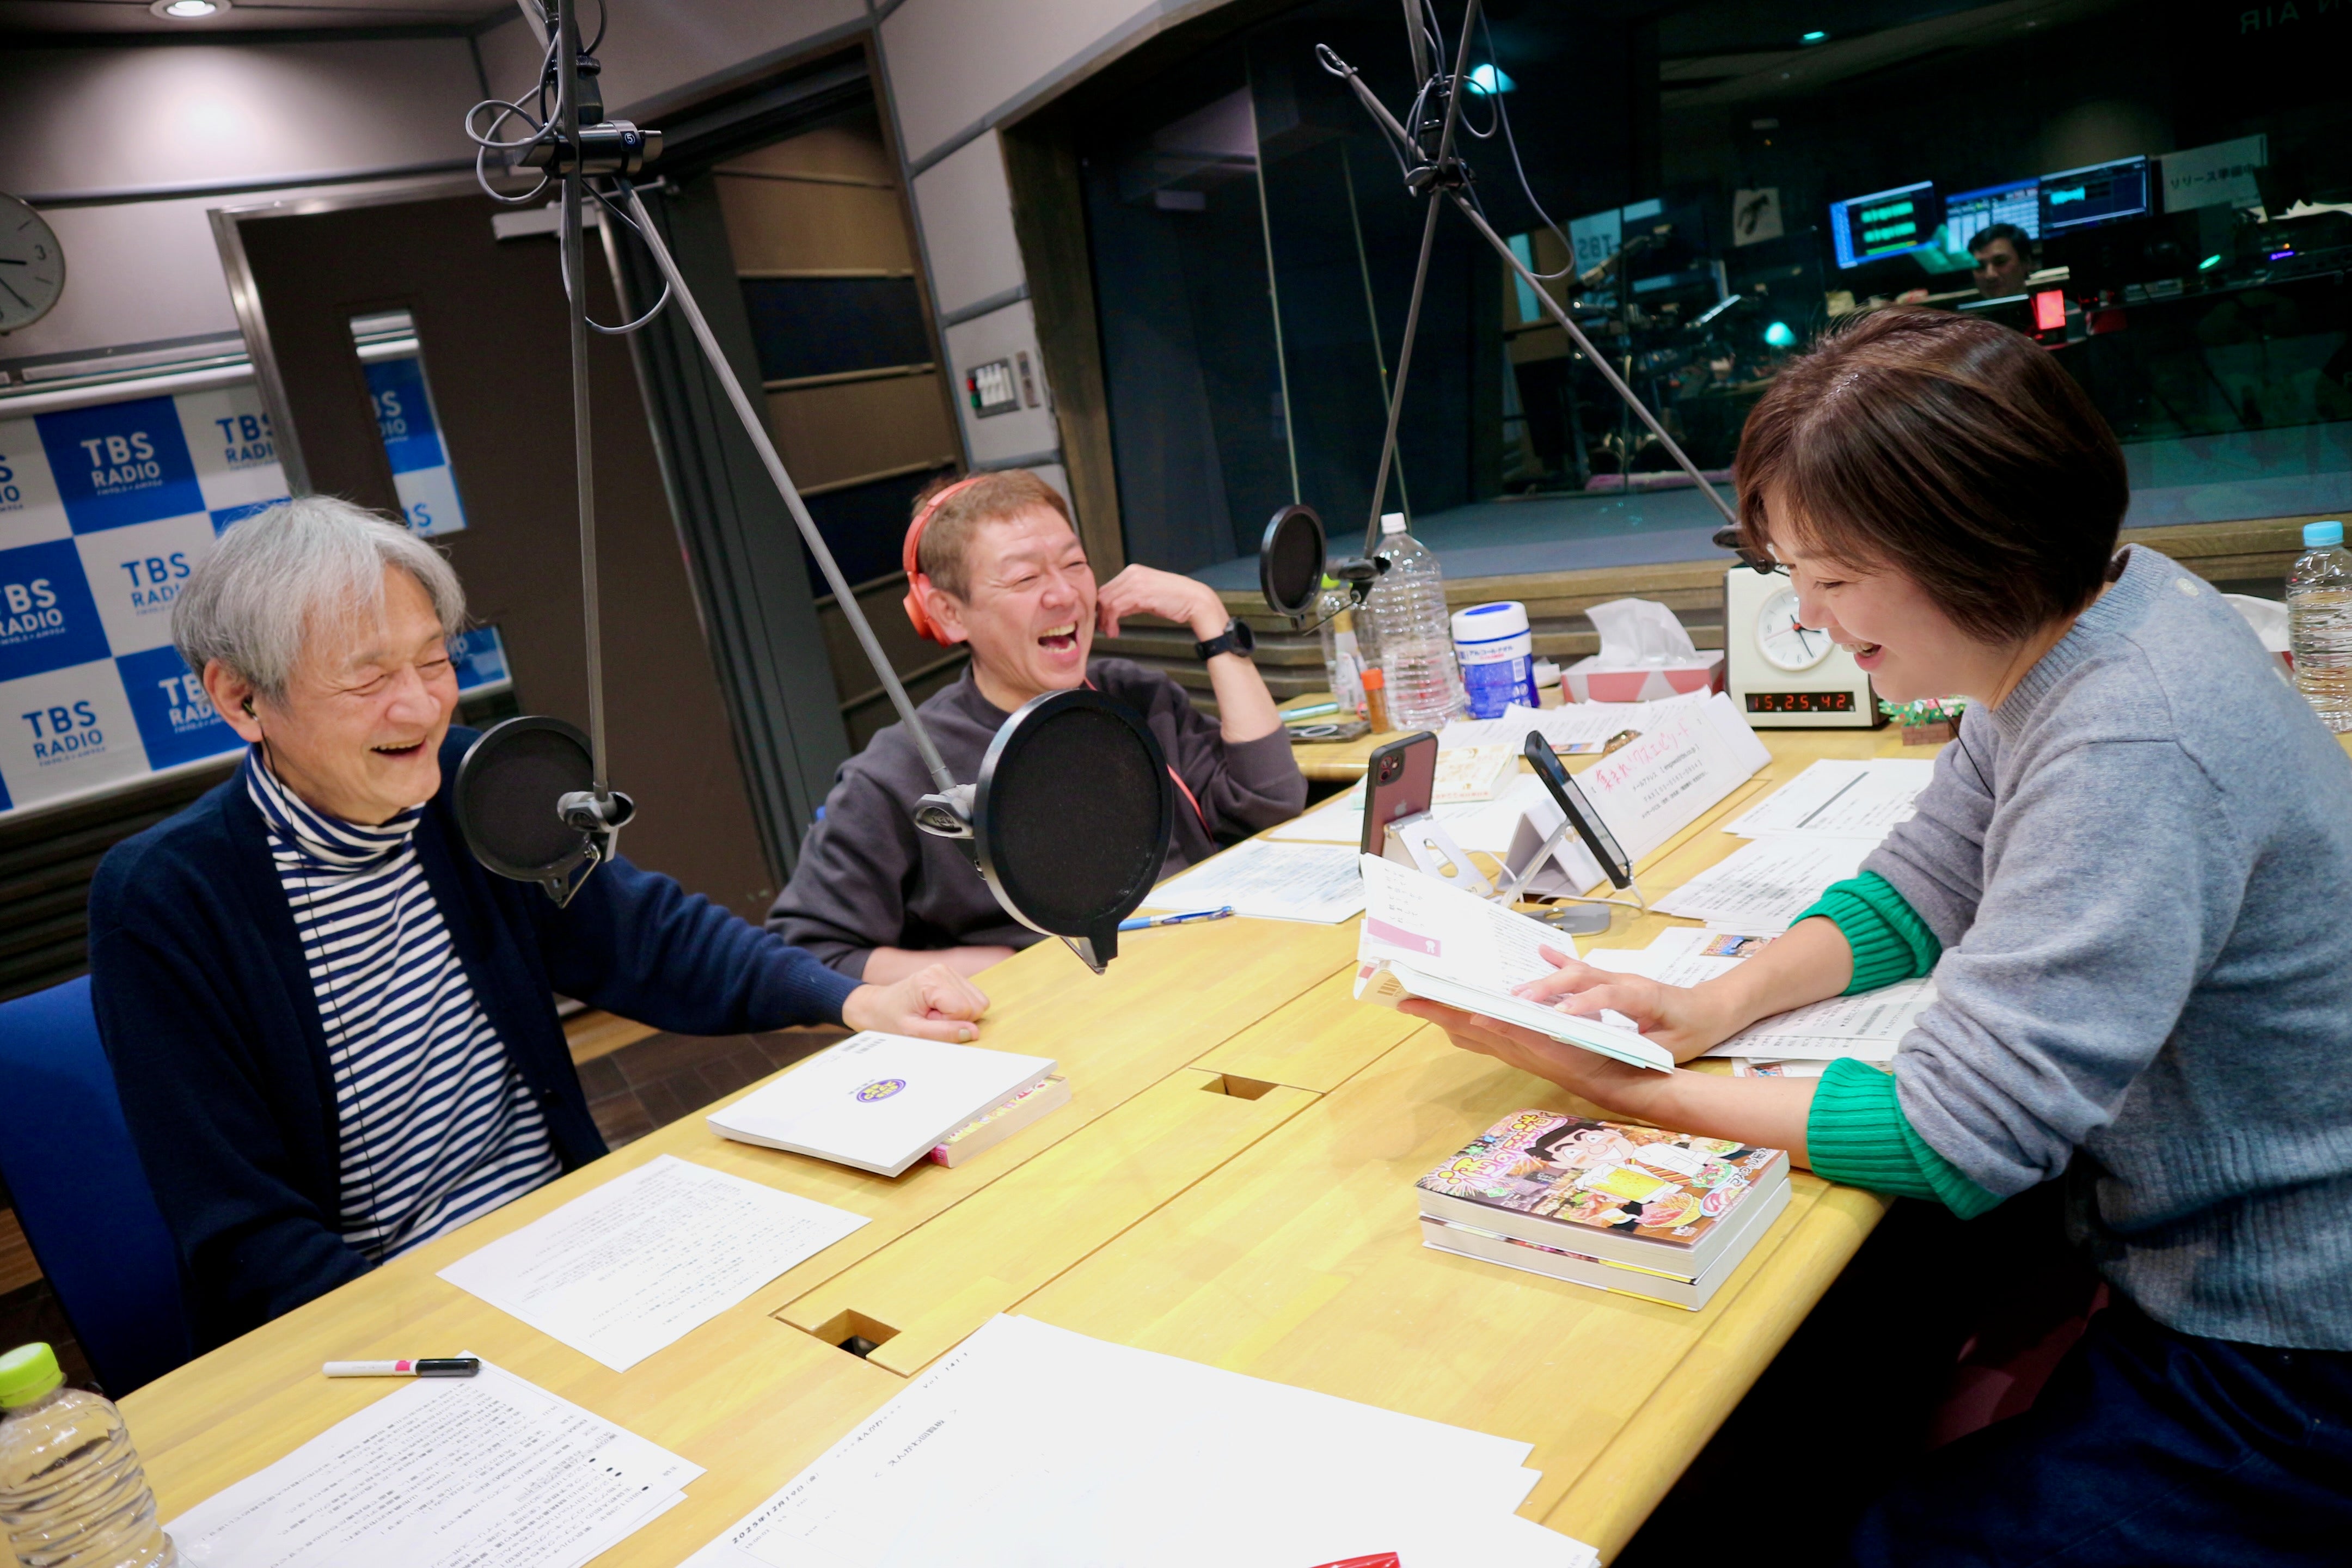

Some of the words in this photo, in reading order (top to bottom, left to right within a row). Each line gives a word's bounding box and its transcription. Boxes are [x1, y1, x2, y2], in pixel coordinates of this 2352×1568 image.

[80, 432, 155, 467] TBS
[91, 461, 161, 488] RADIO
[121, 552, 190, 587] TBS
[0, 579, 57, 615] BS
[1753, 695, 1773, 709] 15
[1785, 695, 1809, 709] 25
[1821, 694, 1846, 708] 42
[22, 700, 96, 739] TBS
[33, 729, 103, 759] RADIO
